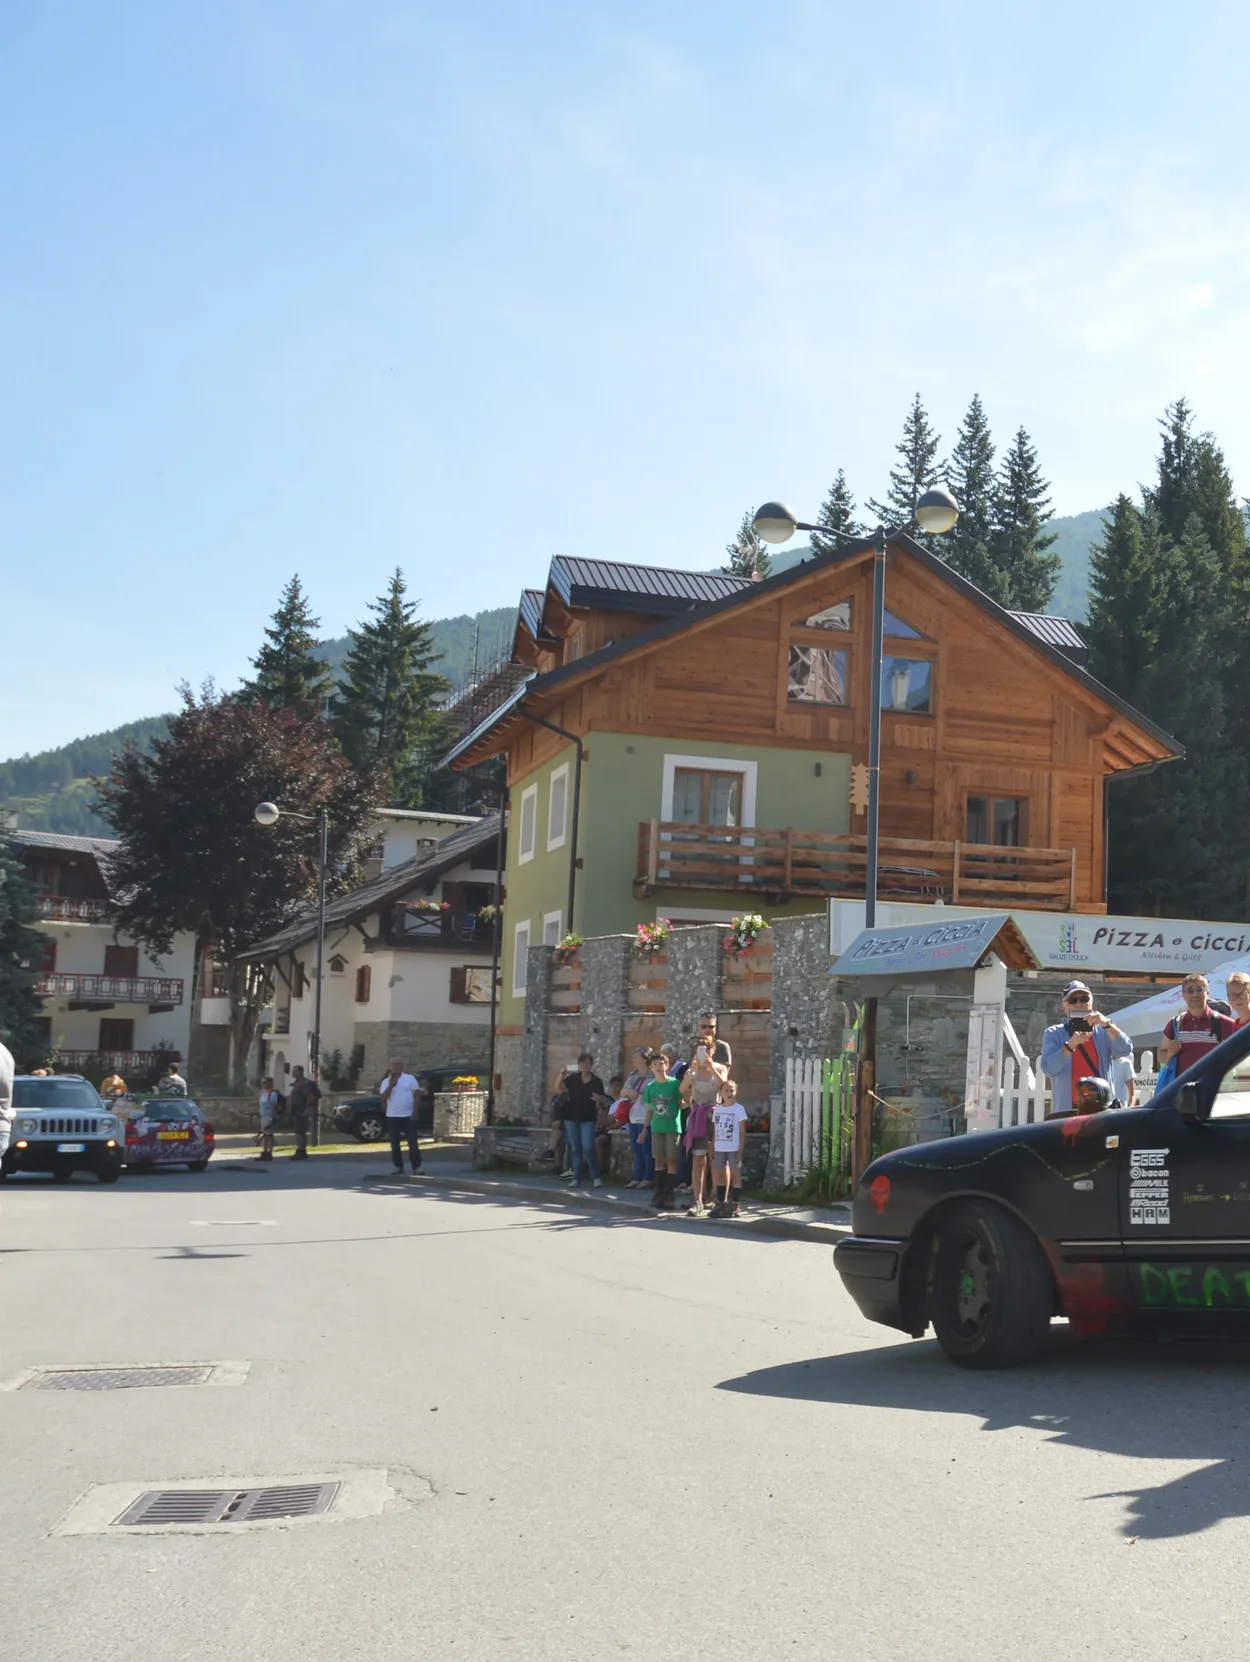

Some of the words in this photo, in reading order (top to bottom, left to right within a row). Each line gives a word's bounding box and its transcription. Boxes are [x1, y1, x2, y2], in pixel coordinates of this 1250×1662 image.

[1142, 952, 1172, 960] Kitchen
[1130, 1148, 1170, 1166] EGGS
[1130, 1188, 1169, 1198] PEPPER
